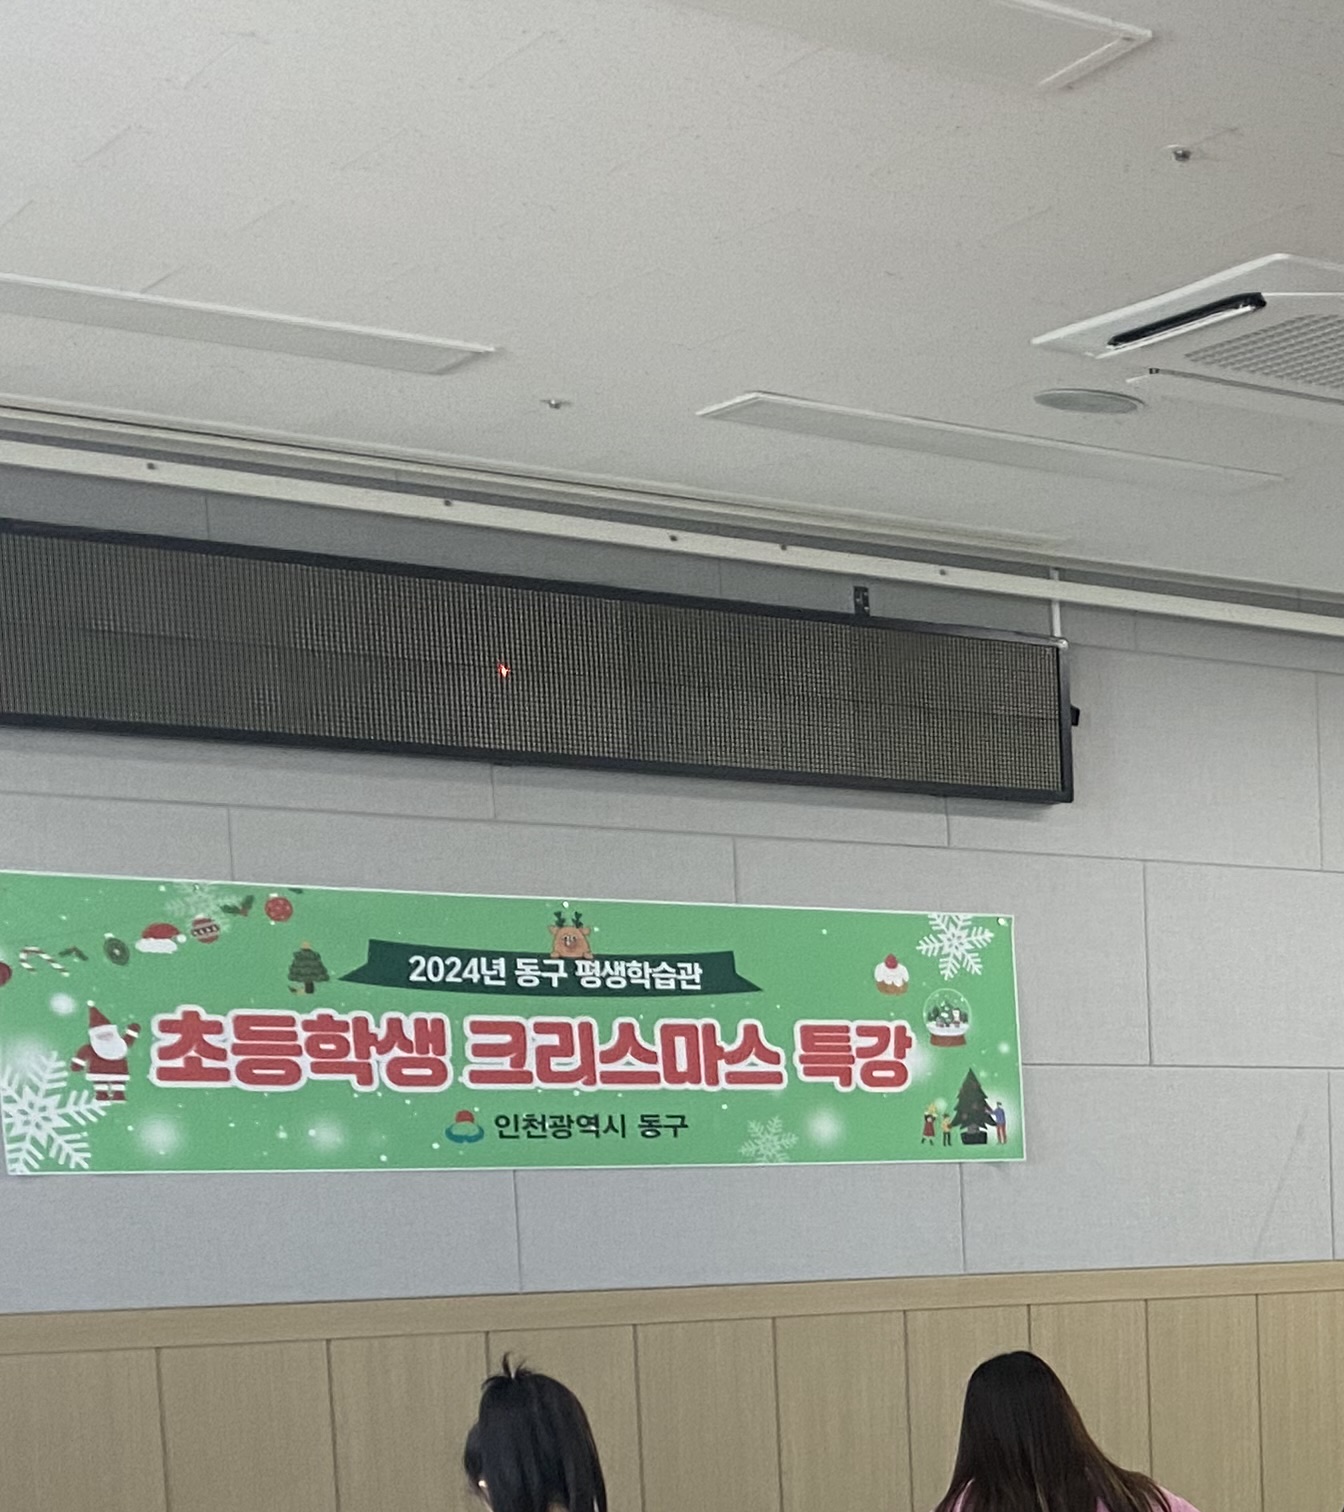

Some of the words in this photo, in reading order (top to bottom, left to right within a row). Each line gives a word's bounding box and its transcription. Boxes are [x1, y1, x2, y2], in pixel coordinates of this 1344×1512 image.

[408, 954, 507, 987] 2024년
[514, 957, 569, 988] 동구
[574, 959, 703, 990] 평생학습관
[152, 1006, 451, 1091] 초등학생
[464, 1016, 787, 1091] 크리스마스
[796, 1021, 915, 1092] 특강
[494, 1113, 627, 1140] 인천광역시
[637, 1114, 690, 1139] 동구
